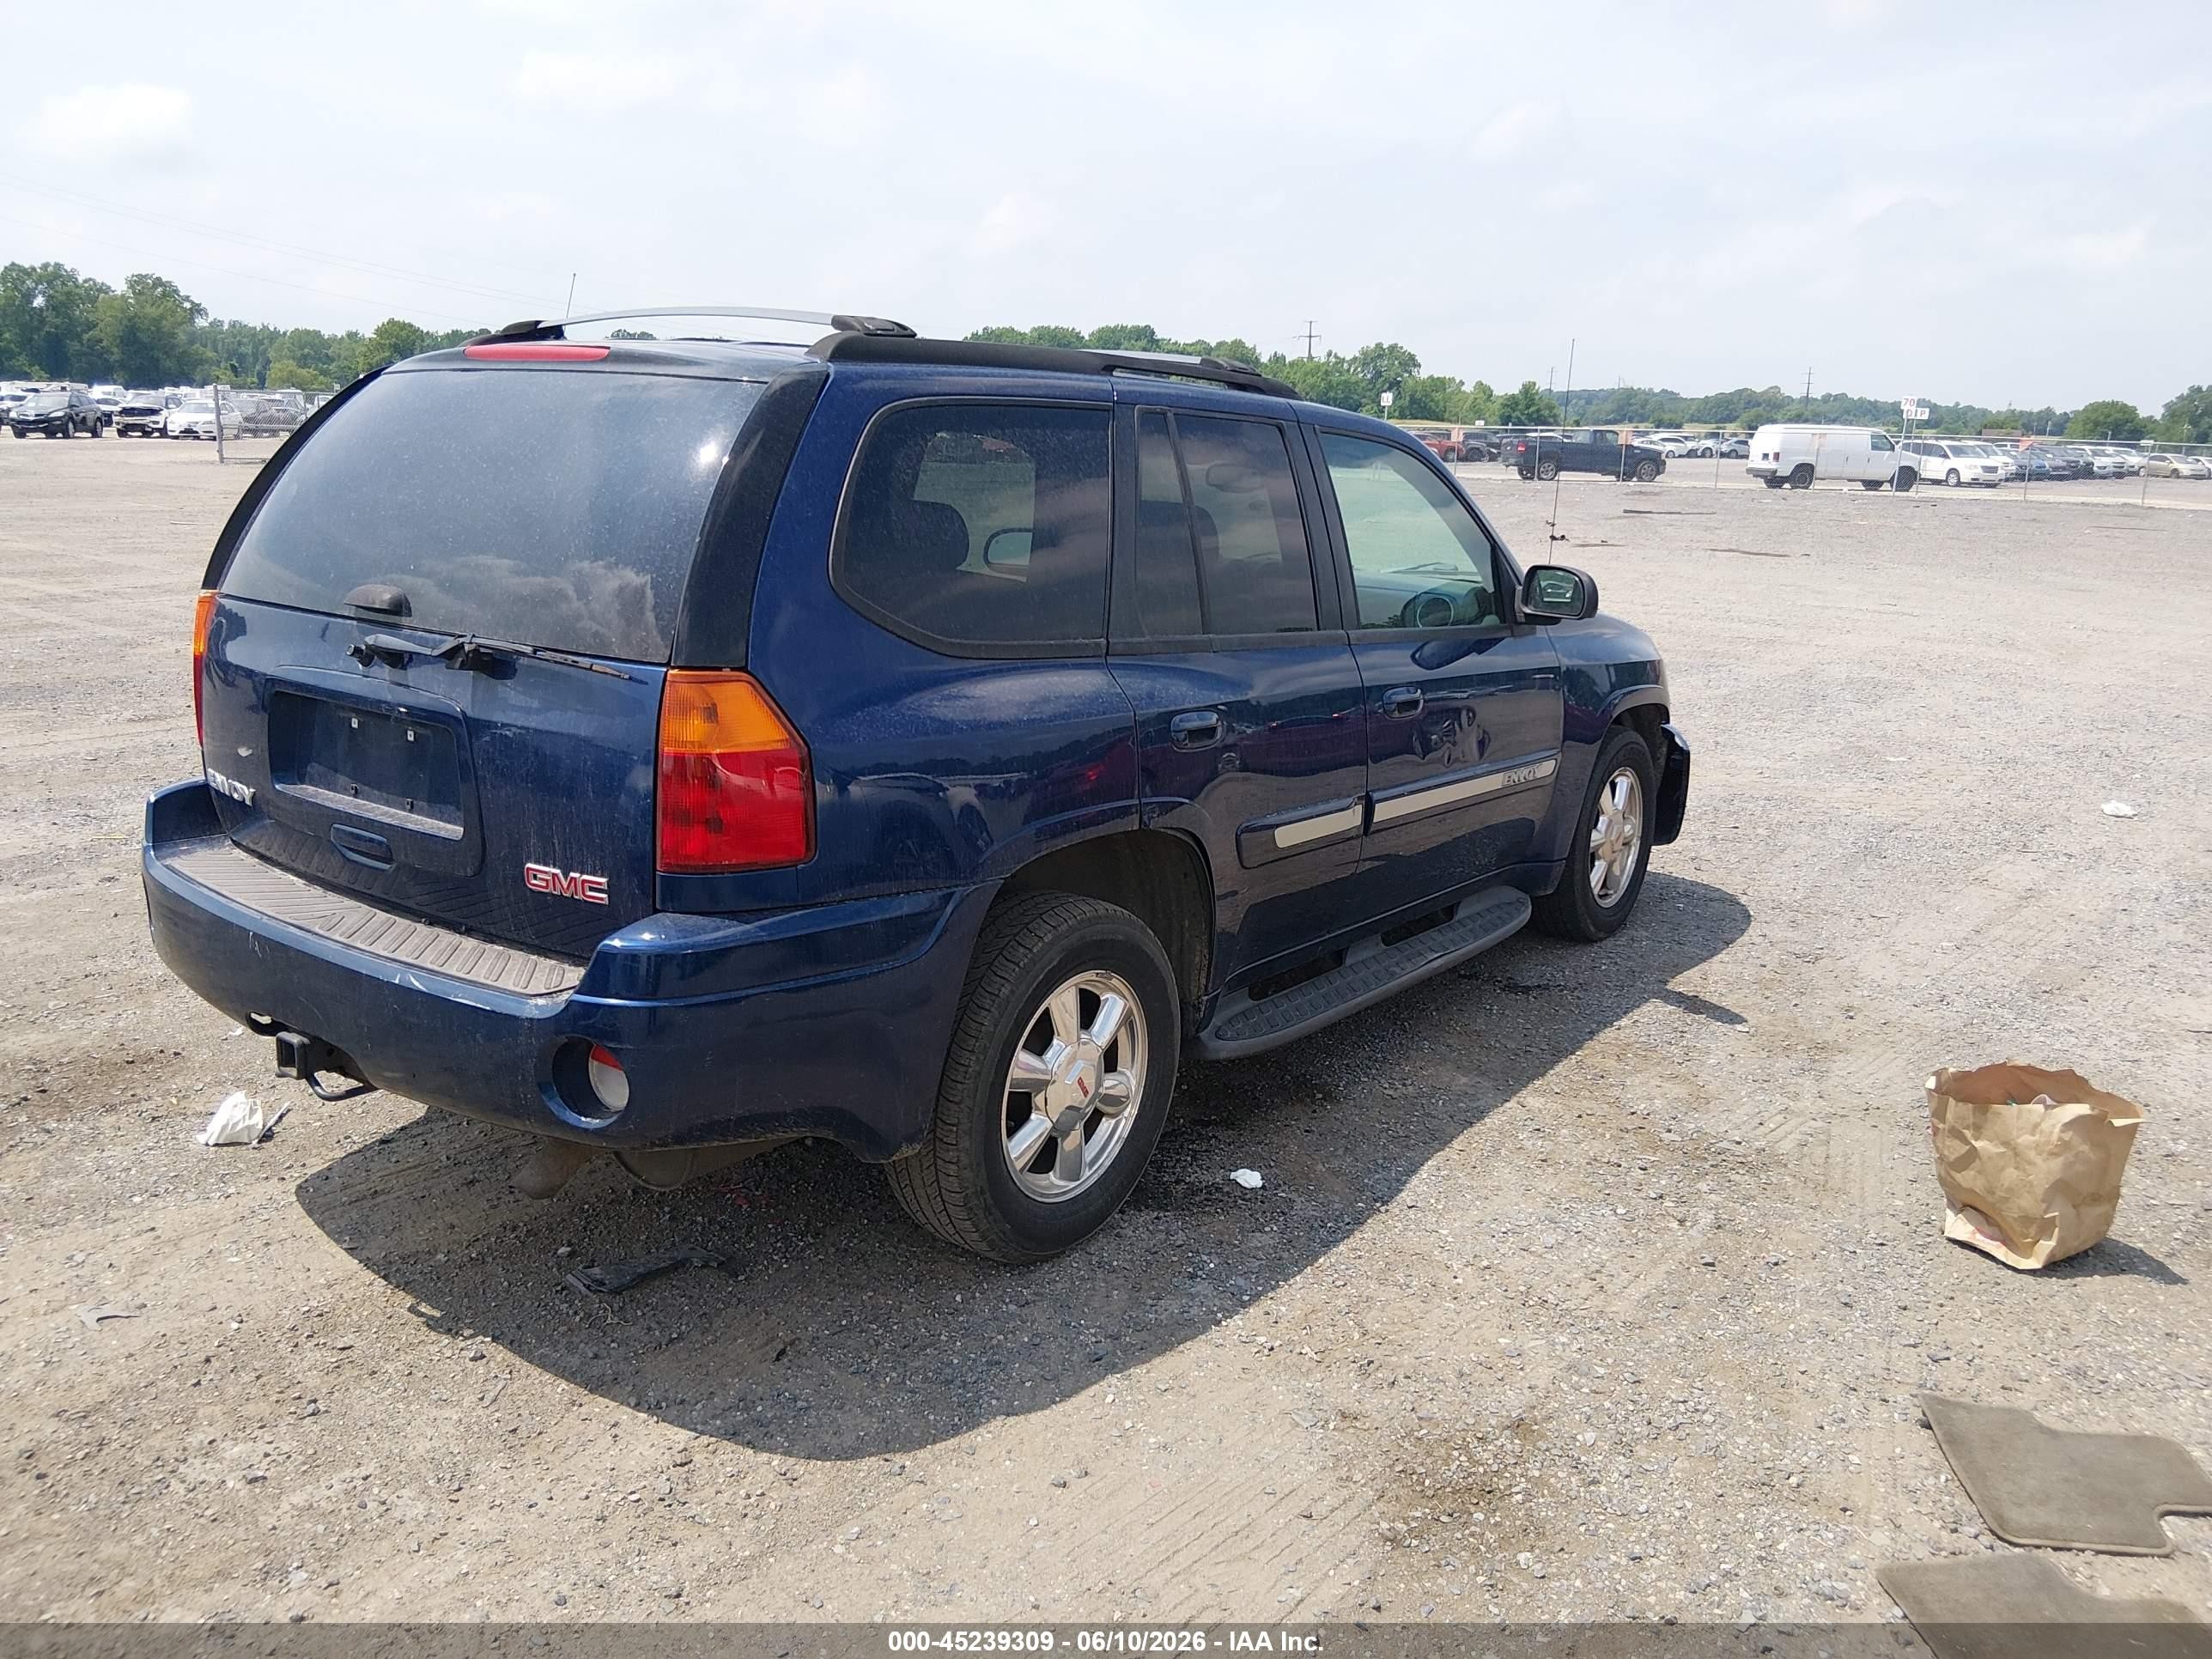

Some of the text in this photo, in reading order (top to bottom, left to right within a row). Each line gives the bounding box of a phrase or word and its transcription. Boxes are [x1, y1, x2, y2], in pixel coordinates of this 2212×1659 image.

[1903, 398, 1916, 407] 70
[207, 768, 257, 807] ENVOY
[524, 862, 610, 905] GMC
